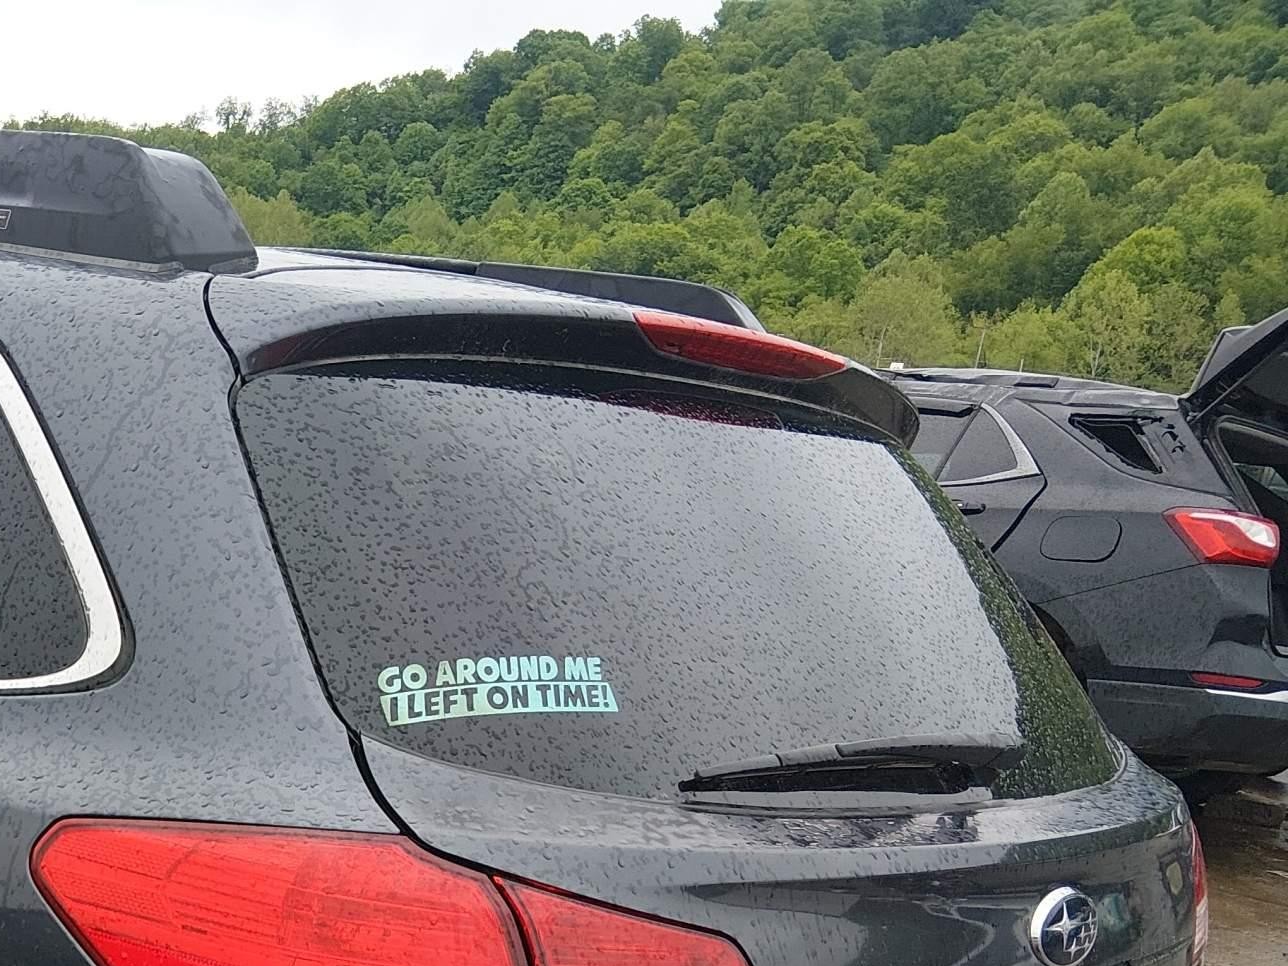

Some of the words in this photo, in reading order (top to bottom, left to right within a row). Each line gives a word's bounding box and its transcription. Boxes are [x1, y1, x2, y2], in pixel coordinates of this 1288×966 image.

[377, 663, 428, 693] GO
[435, 655, 559, 686] AROUND
[564, 656, 602, 681] ME
[389, 696, 399, 722] I
[407, 688, 478, 719] LEFT
[486, 686, 529, 710] ON
[535, 684, 610, 709] TIME!
